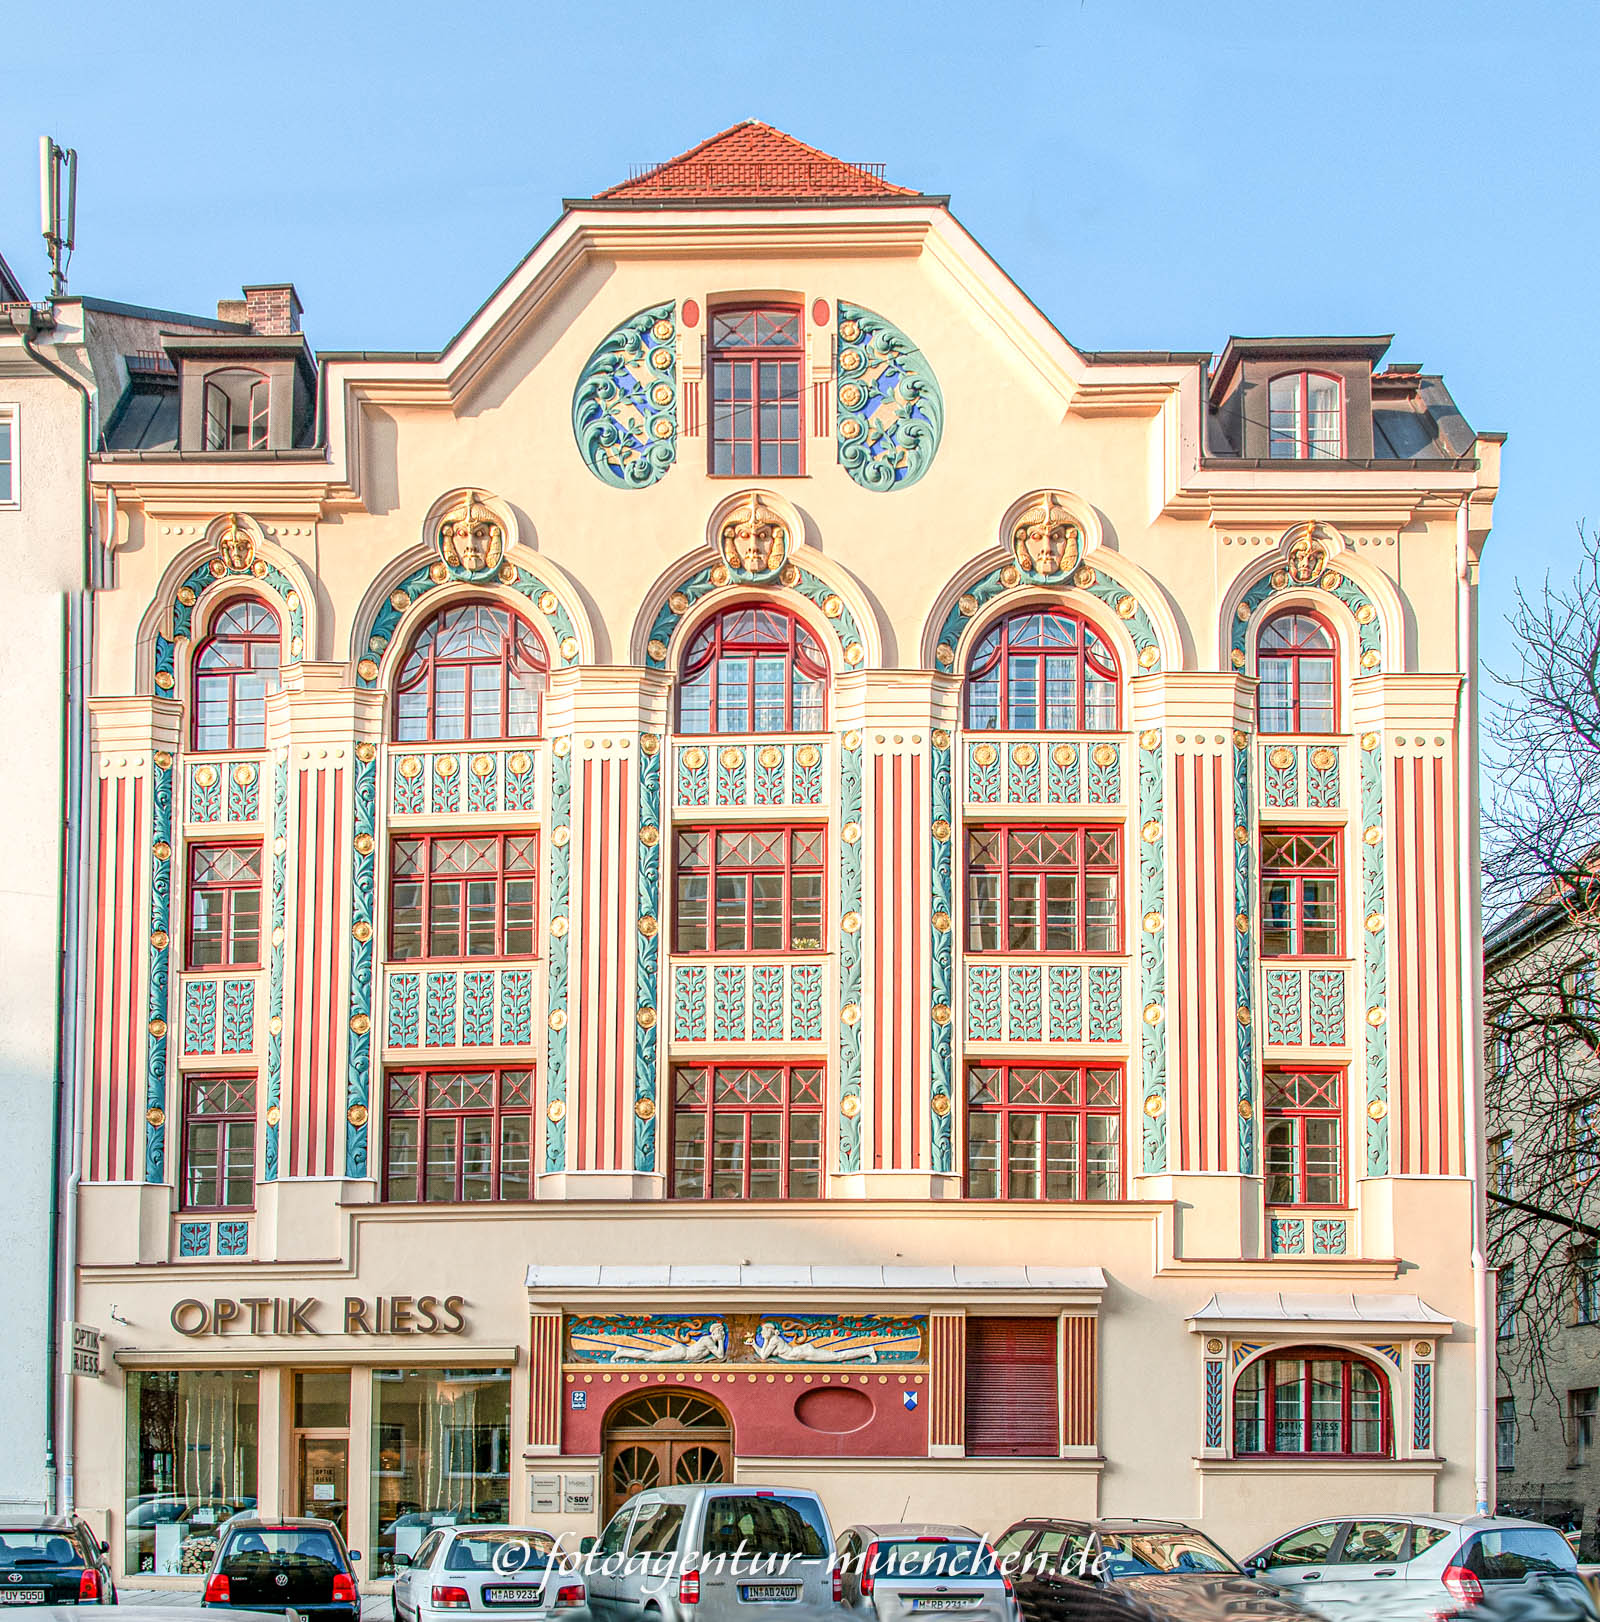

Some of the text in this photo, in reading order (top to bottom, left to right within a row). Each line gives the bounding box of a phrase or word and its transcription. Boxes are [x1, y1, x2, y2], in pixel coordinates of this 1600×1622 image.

[170, 1295, 466, 1336] OPTIK RIESS
[74, 1328, 99, 1349] OPTIK
[74, 1352, 99, 1373] RIESS
[574, 1392, 584, 1401] 22
[1278, 1421, 1339, 1431] OPTIK RIESS
[5, 1591, 44, 1600] UY 5050
[491, 1589, 538, 1600] M AB 9231
[749, 1587, 759, 1596] IN
[775, 1587, 795, 1597] 2407
[919, 1600, 926, 1609] M
[931, 1600, 944, 1609] RB
